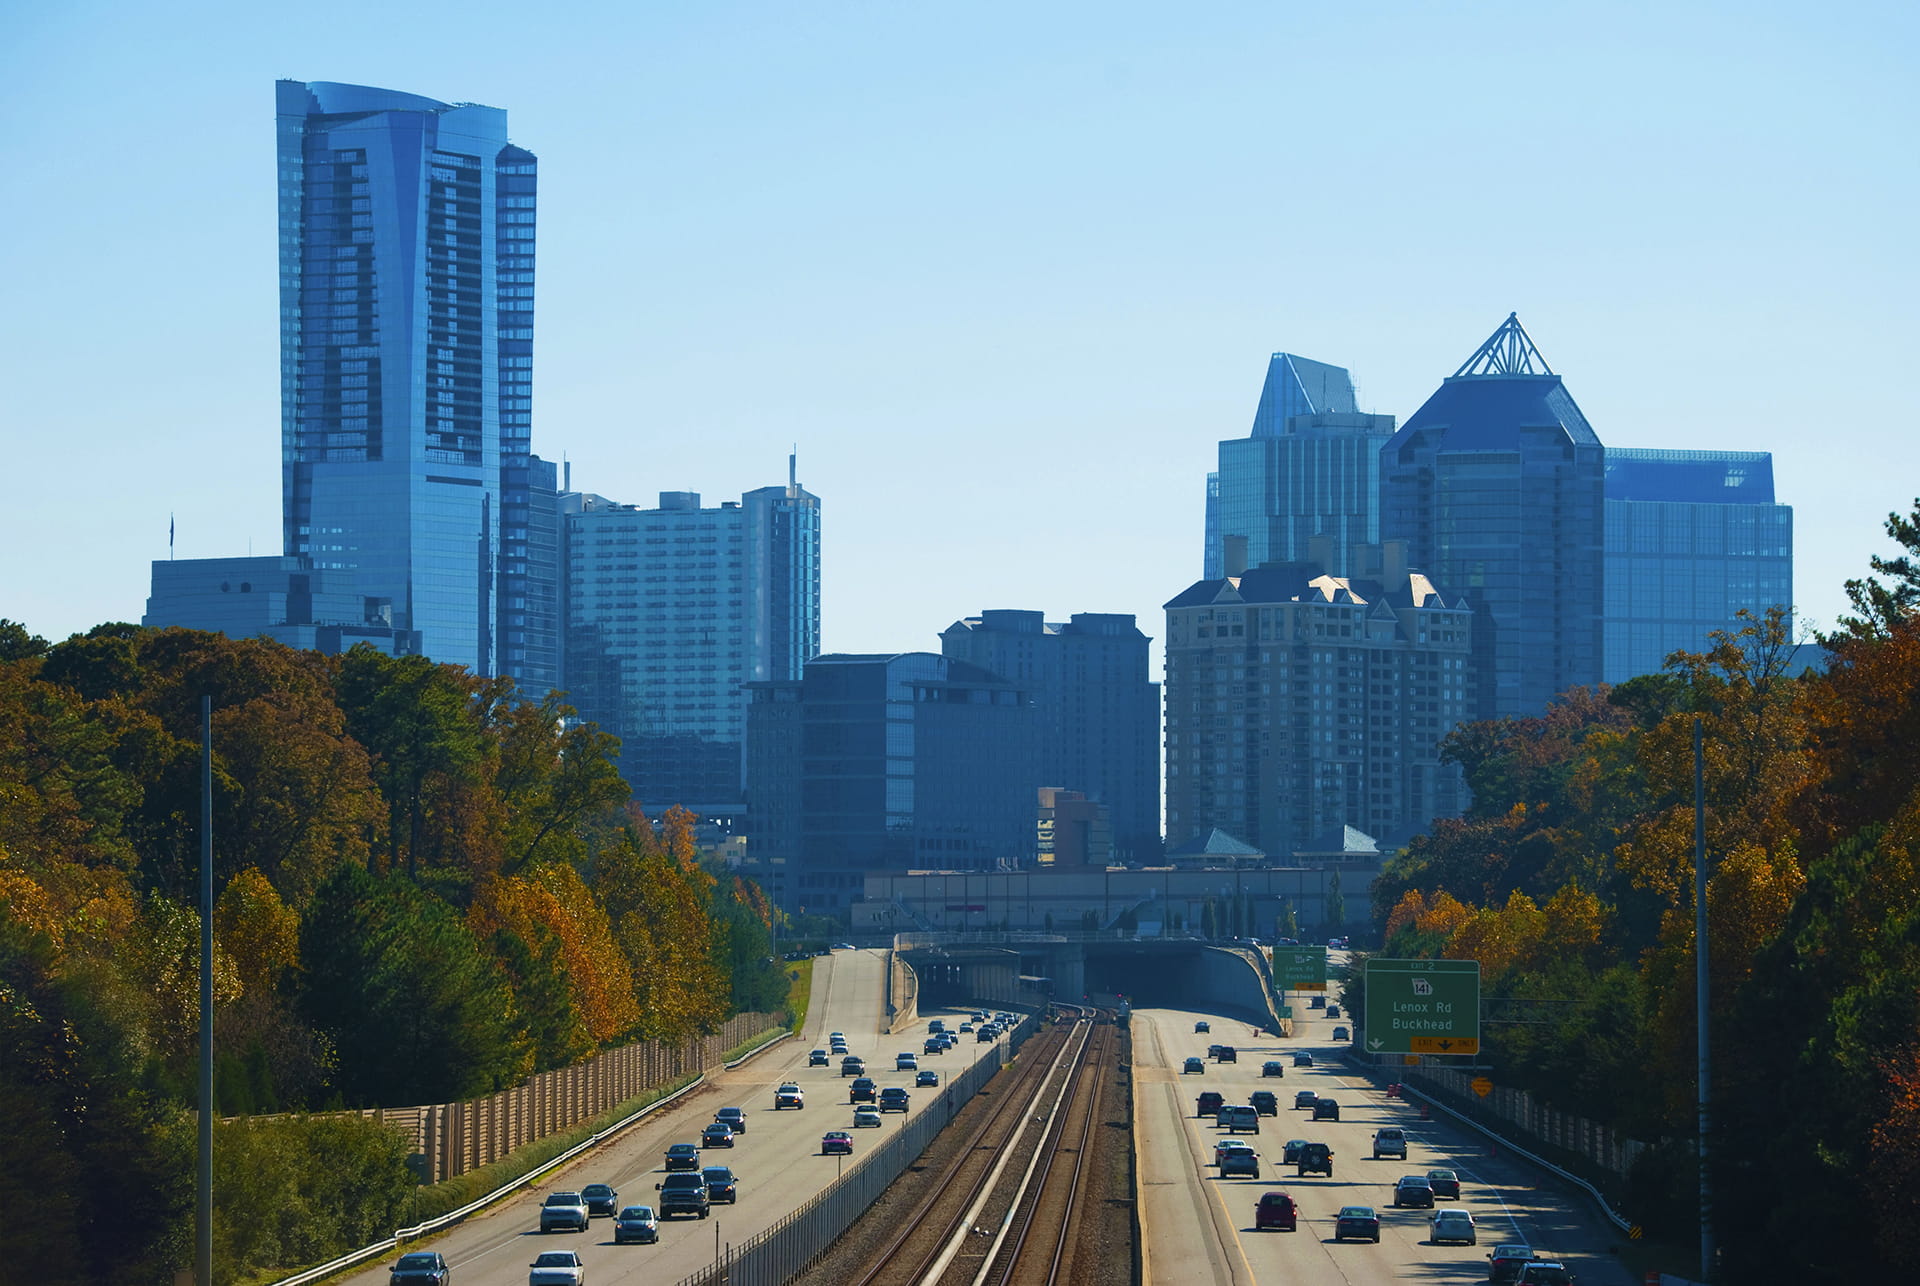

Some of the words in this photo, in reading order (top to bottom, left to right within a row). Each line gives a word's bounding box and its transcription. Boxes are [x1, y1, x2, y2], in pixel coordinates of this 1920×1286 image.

[1427, 961, 1435, 970] 2
[1415, 983, 1430, 994] 141
[1393, 1001, 1428, 1013] Lenox
[1436, 1002, 1452, 1014] Rd
[1392, 1018, 1453, 1031] Buckhead
